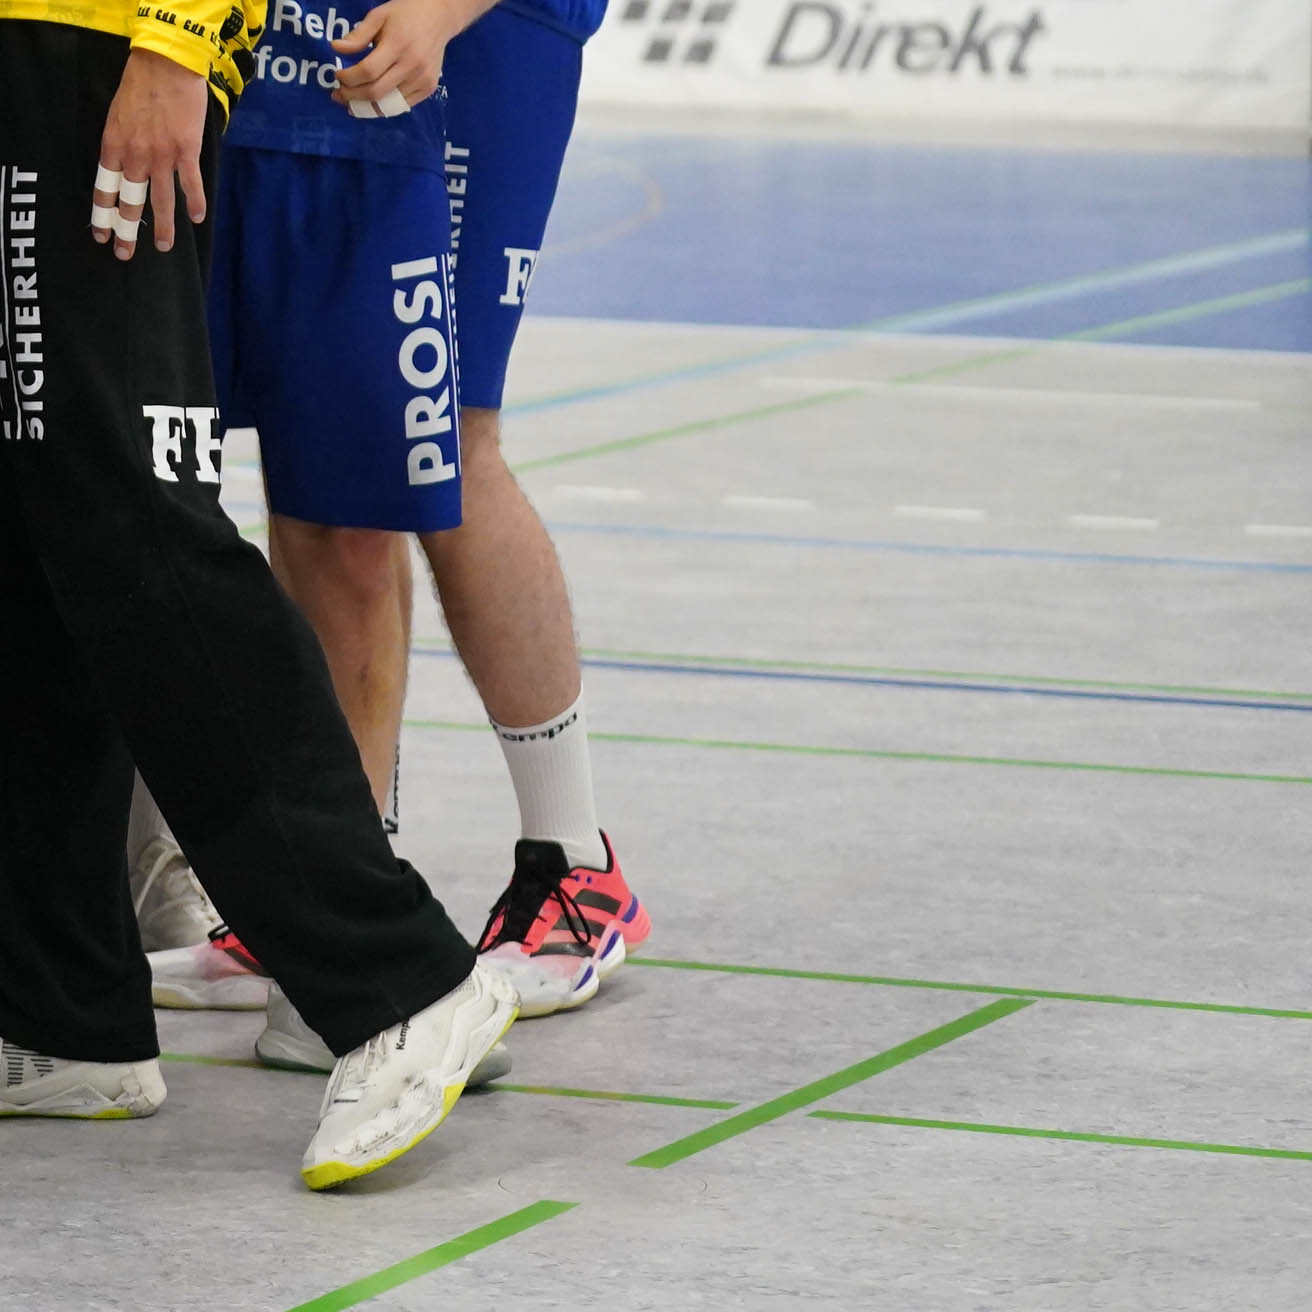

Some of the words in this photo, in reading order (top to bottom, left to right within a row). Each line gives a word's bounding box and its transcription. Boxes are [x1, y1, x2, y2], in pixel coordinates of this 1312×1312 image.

[9, 165, 45, 440] SICHERHEIT
[391, 255, 456, 486] PROSI
[395, 1022, 411, 1050] Kemp
